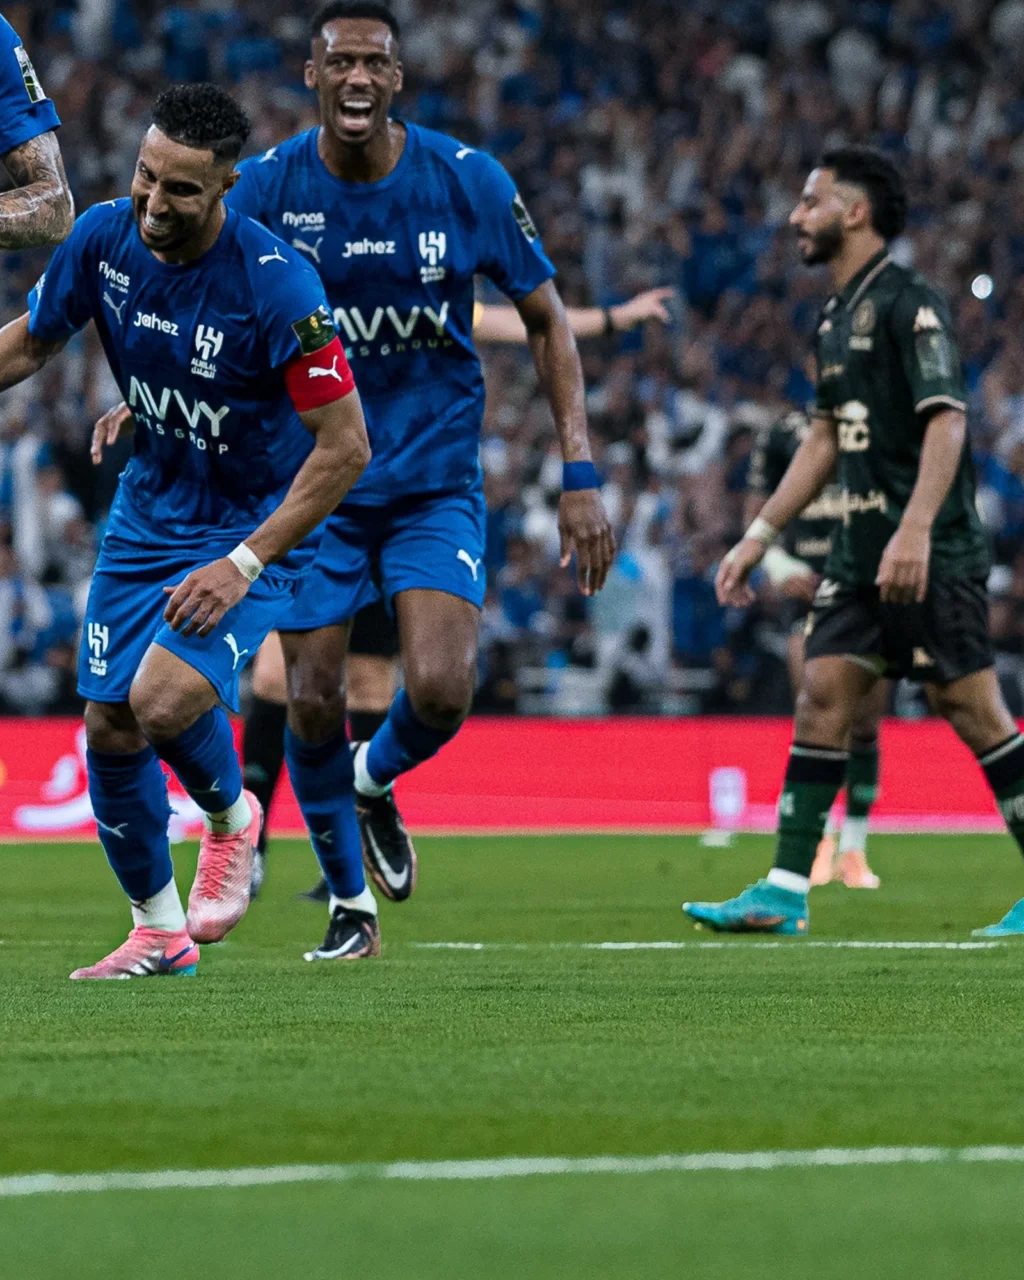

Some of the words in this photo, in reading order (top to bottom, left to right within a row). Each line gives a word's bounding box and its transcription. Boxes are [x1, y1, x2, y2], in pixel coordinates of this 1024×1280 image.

[333, 300, 450, 342] AVVY
[129, 375, 230, 437] AVVY
[174, 428, 229, 455] GROP
